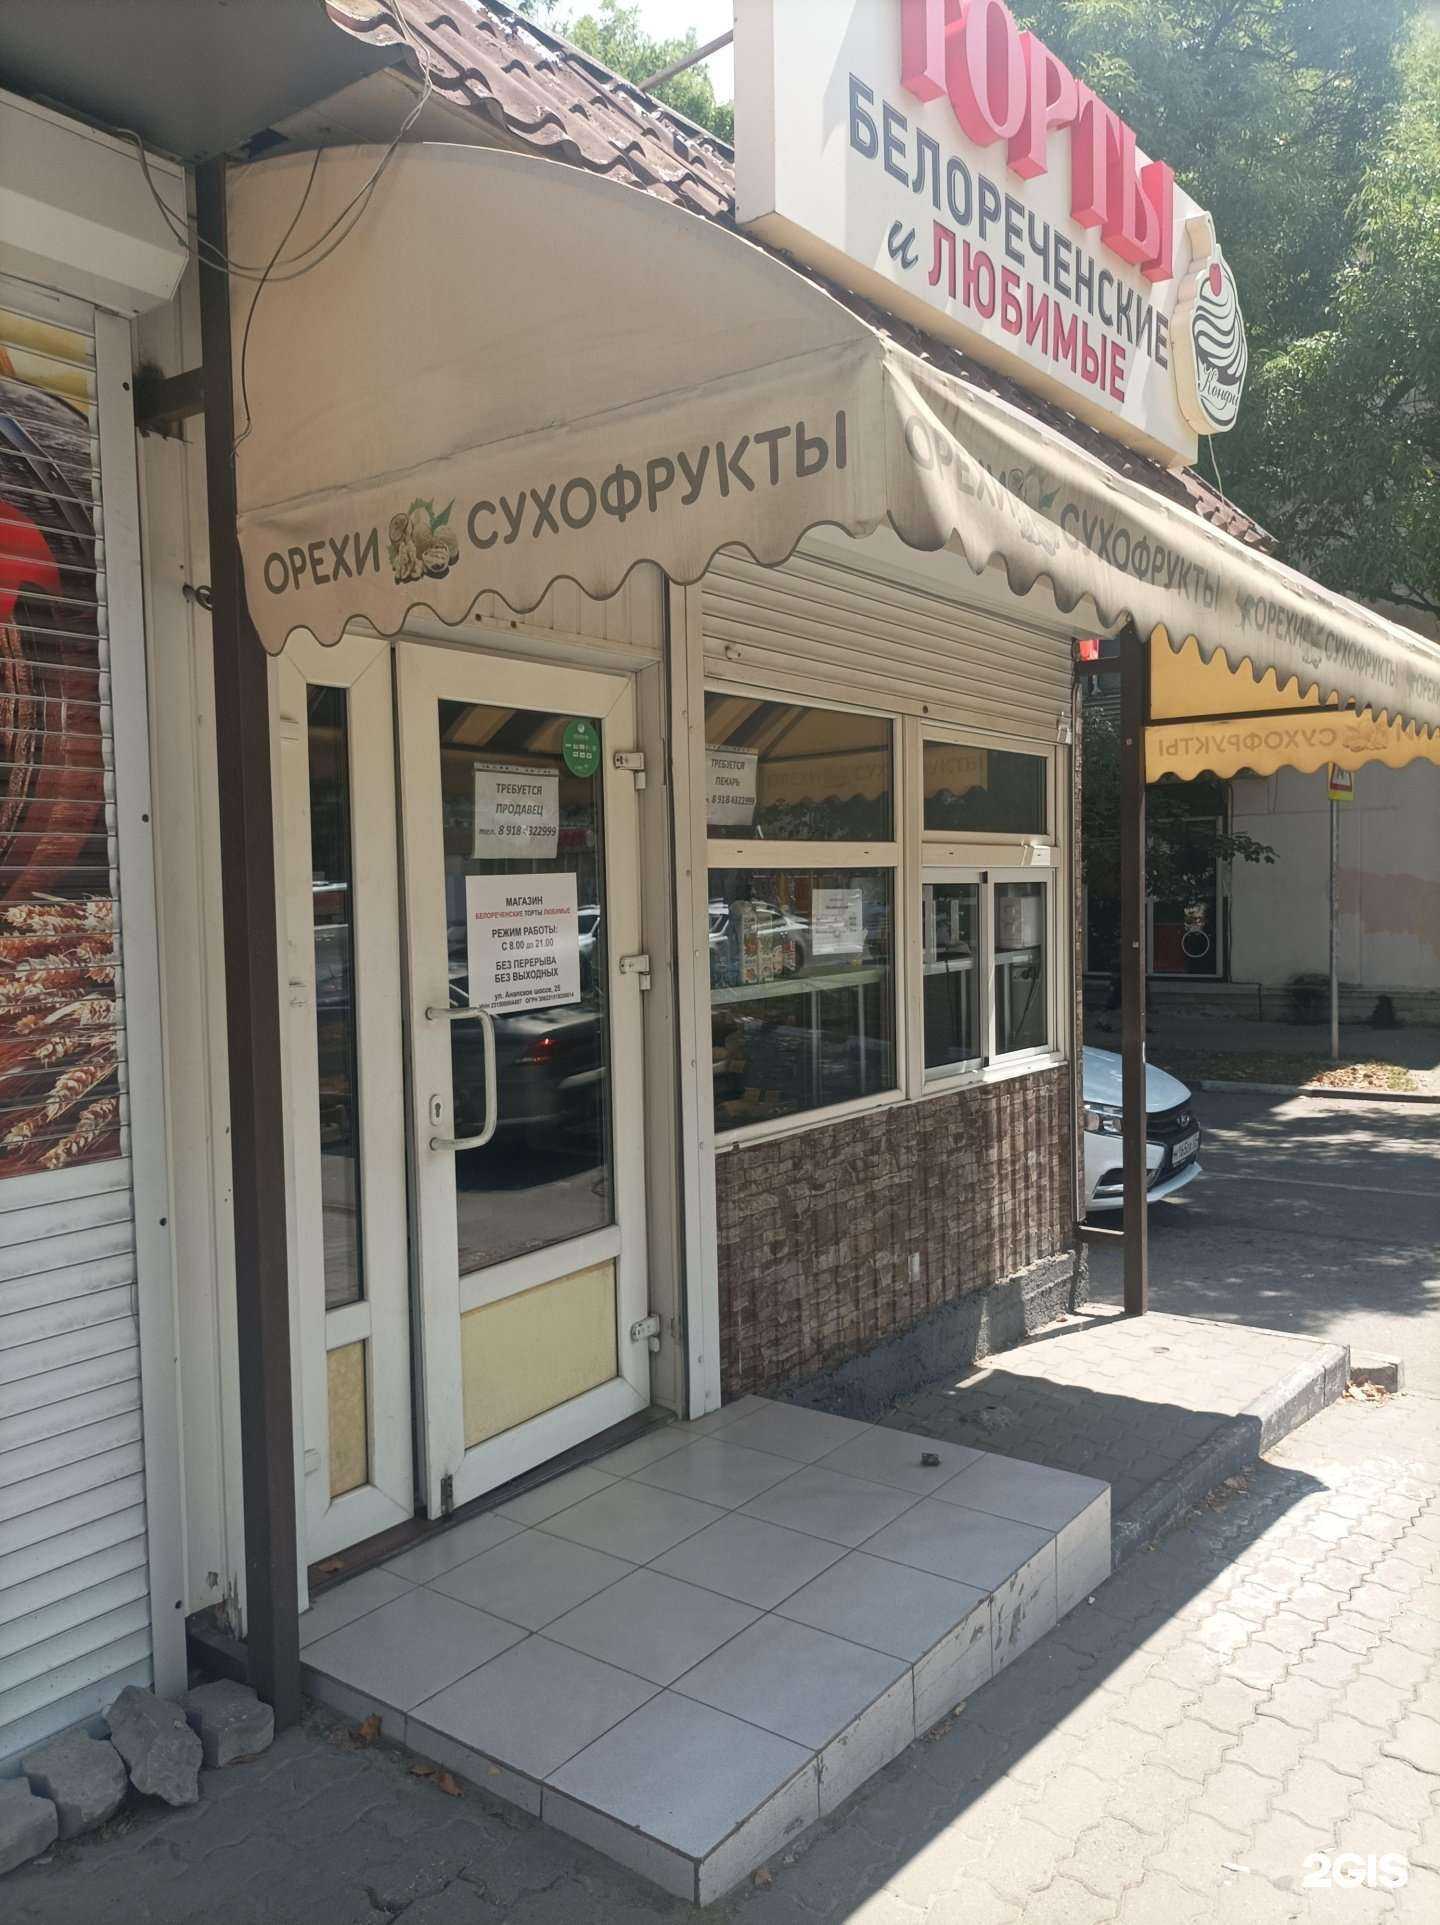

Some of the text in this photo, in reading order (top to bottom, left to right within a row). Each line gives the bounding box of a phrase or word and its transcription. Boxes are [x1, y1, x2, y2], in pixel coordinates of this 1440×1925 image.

[901, 0, 1174, 283] ТОРТЫ
[849, 72, 1169, 370] БЕЛОРЕЧЕНСКИЕ
[887, 219, 1126, 403] и ЛЮБИМЫЕ
[263, 409, 847, 595] ОРЕХИ СУХОФРУКТЫ
[1060, 503, 1221, 612] СУХОФРУКТЫ
[1254, 595, 1398, 689] ОРЕХИ СУХОФРУКТЫ
[496, 783, 543, 796] ТРЕБУЕТСЯ
[495, 803, 544, 817] ПРОДАВЕЦ
[505, 896, 543, 907] МАГАЗИН
[524, 909, 543, 917] ТОРТЫ
[491, 924, 559, 938] РЕЖИМ РАБОТЫ:
[509, 940, 525, 951] 8.00
[495, 956, 557, 971] БЕЗ ПЕРЕРЫВА
[494, 967, 559, 984] БЕЗ ВЫХОДНЫХ
